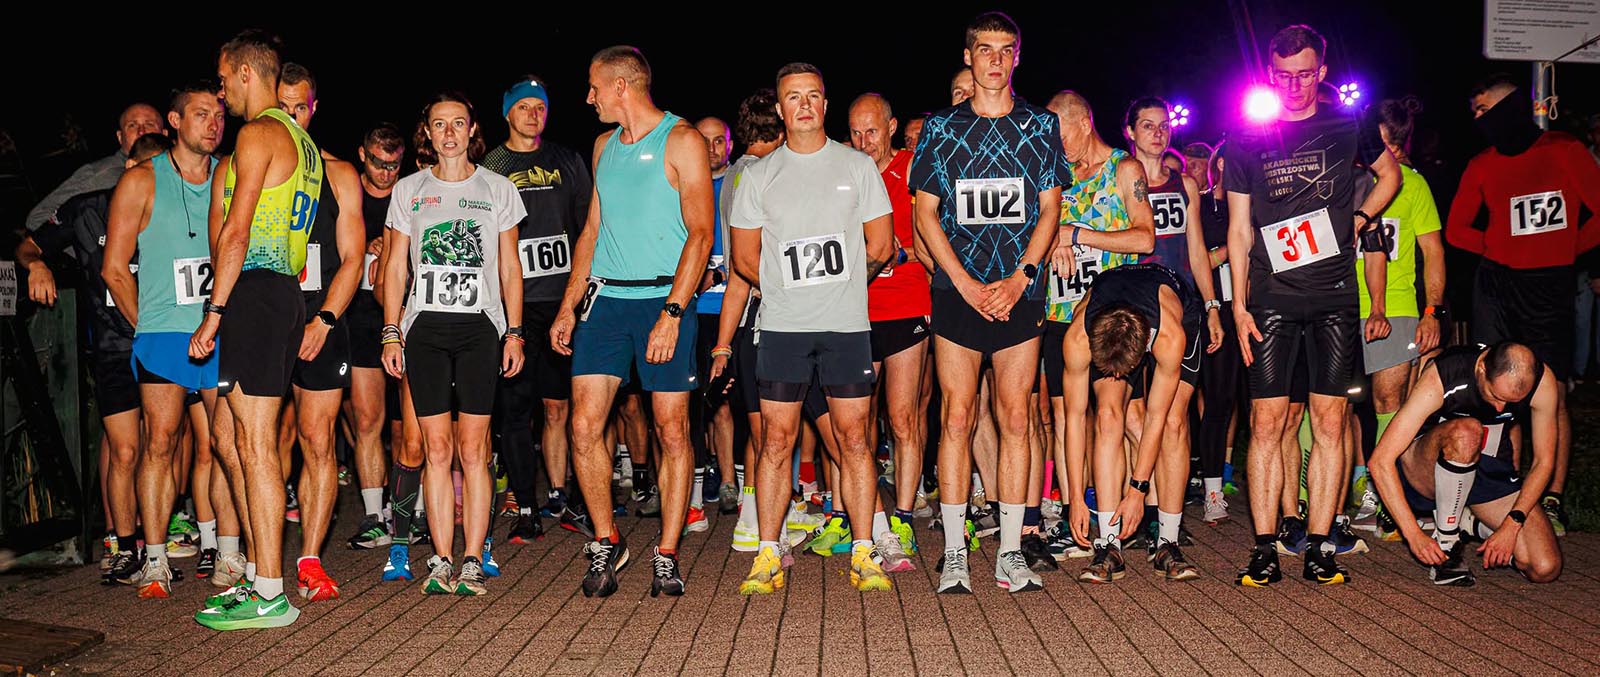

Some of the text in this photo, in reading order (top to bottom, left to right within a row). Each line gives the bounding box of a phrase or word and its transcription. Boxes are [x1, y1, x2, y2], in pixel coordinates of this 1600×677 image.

[961, 184, 1021, 218] 102
[1514, 196, 1563, 229] 152
[523, 240, 567, 272] 160
[1277, 220, 1319, 262] 31
[784, 239, 844, 280] 120
[421, 271, 478, 306] 135
[1053, 260, 1099, 297] 145
